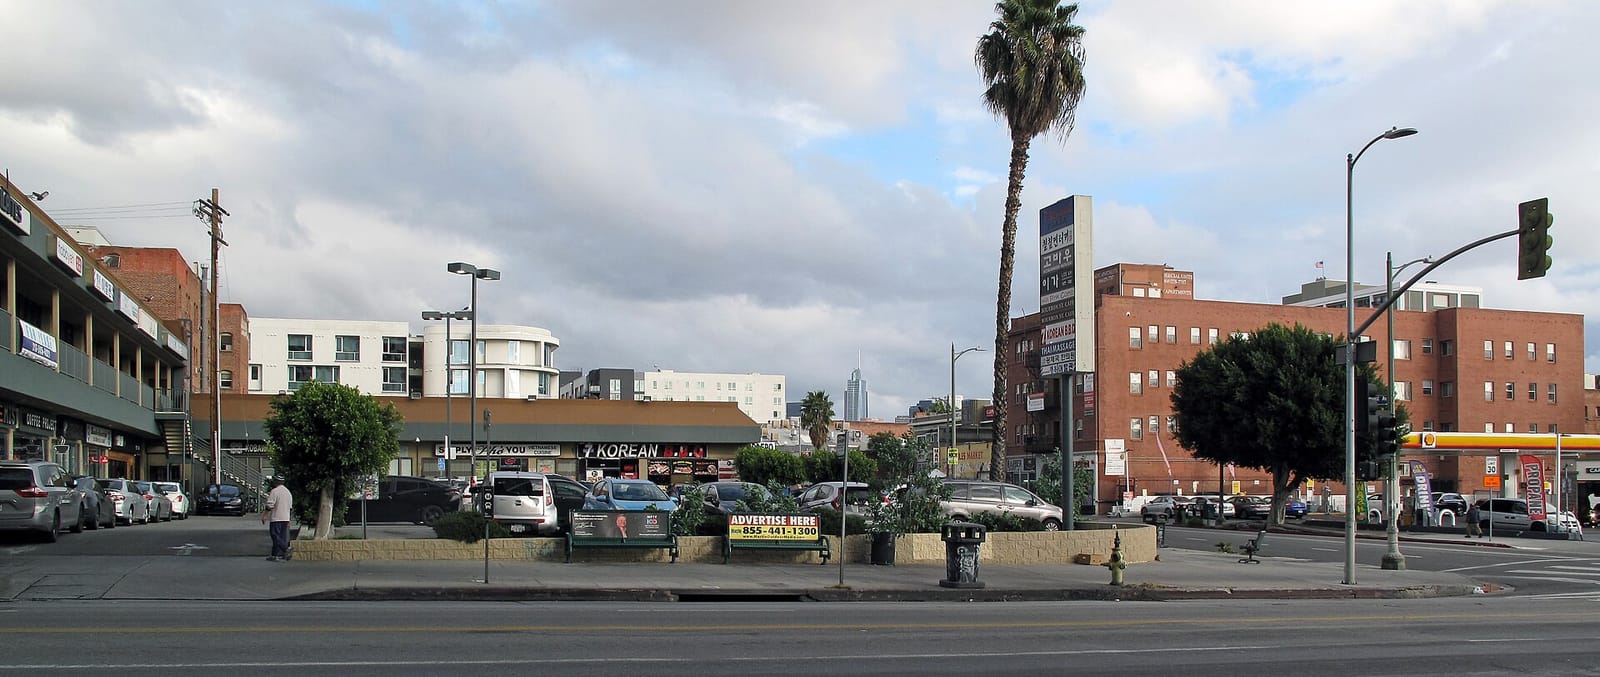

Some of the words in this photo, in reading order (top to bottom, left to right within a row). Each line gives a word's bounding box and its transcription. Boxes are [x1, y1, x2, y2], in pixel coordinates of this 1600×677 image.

[1042, 274, 1059, 291] 이가
[26, 413, 41, 427] COFFEE
[42, 416, 57, 432] PROJECT
[505, 446, 526, 454] YOU
[596, 443, 659, 458] KOREAN
[1487, 465, 1496, 473] 30
[1525, 463, 1544, 516] PROPANE
[731, 515, 787, 525] ADVERTISE
[790, 516, 816, 526] HERE
[743, 526, 817, 535] 855-441-1300
